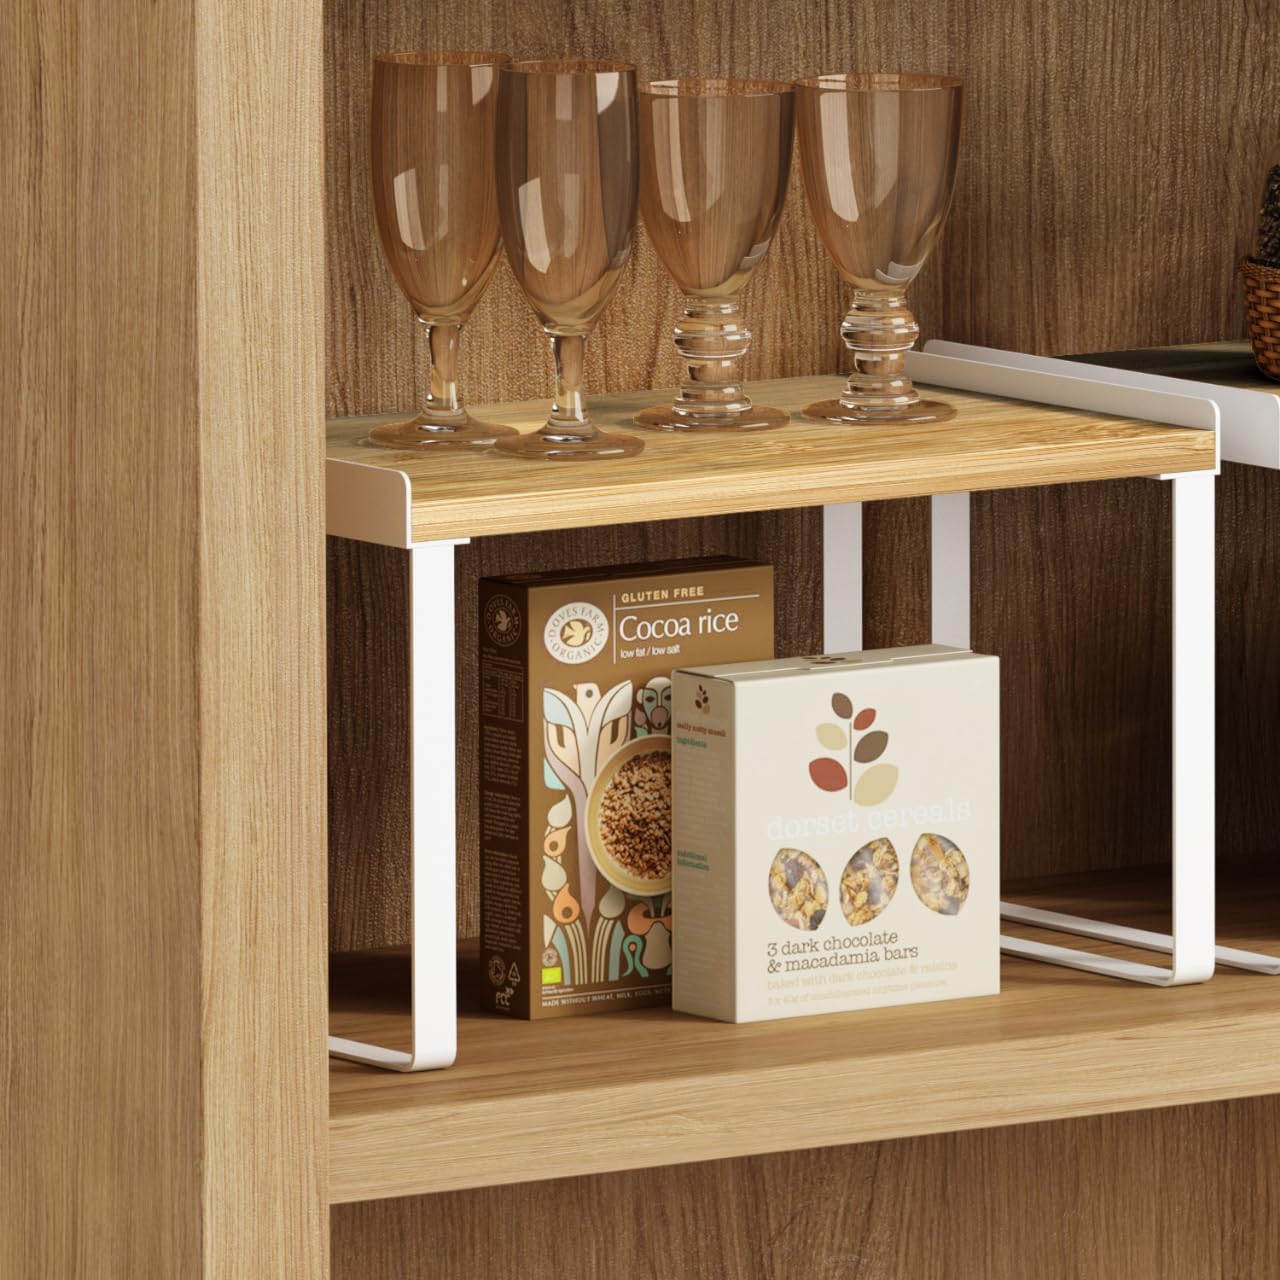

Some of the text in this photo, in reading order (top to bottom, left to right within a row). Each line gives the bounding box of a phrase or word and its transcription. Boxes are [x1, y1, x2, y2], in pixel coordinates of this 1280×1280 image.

[621, 586, 705, 603] GLUTEN FREE
[619, 608, 740, 642] Cocoa rice
[550, 639, 602, 662] ORGANIC
[620, 648, 634, 659] low
[635, 647, 646, 658] fat
[651, 645, 666, 657] low
[666, 644, 681, 655] salt
[767, 797, 971, 841] dorset cereals
[767, 931, 899, 958] 3 dark chocolate
[767, 945, 919, 974] & macadamia bars
